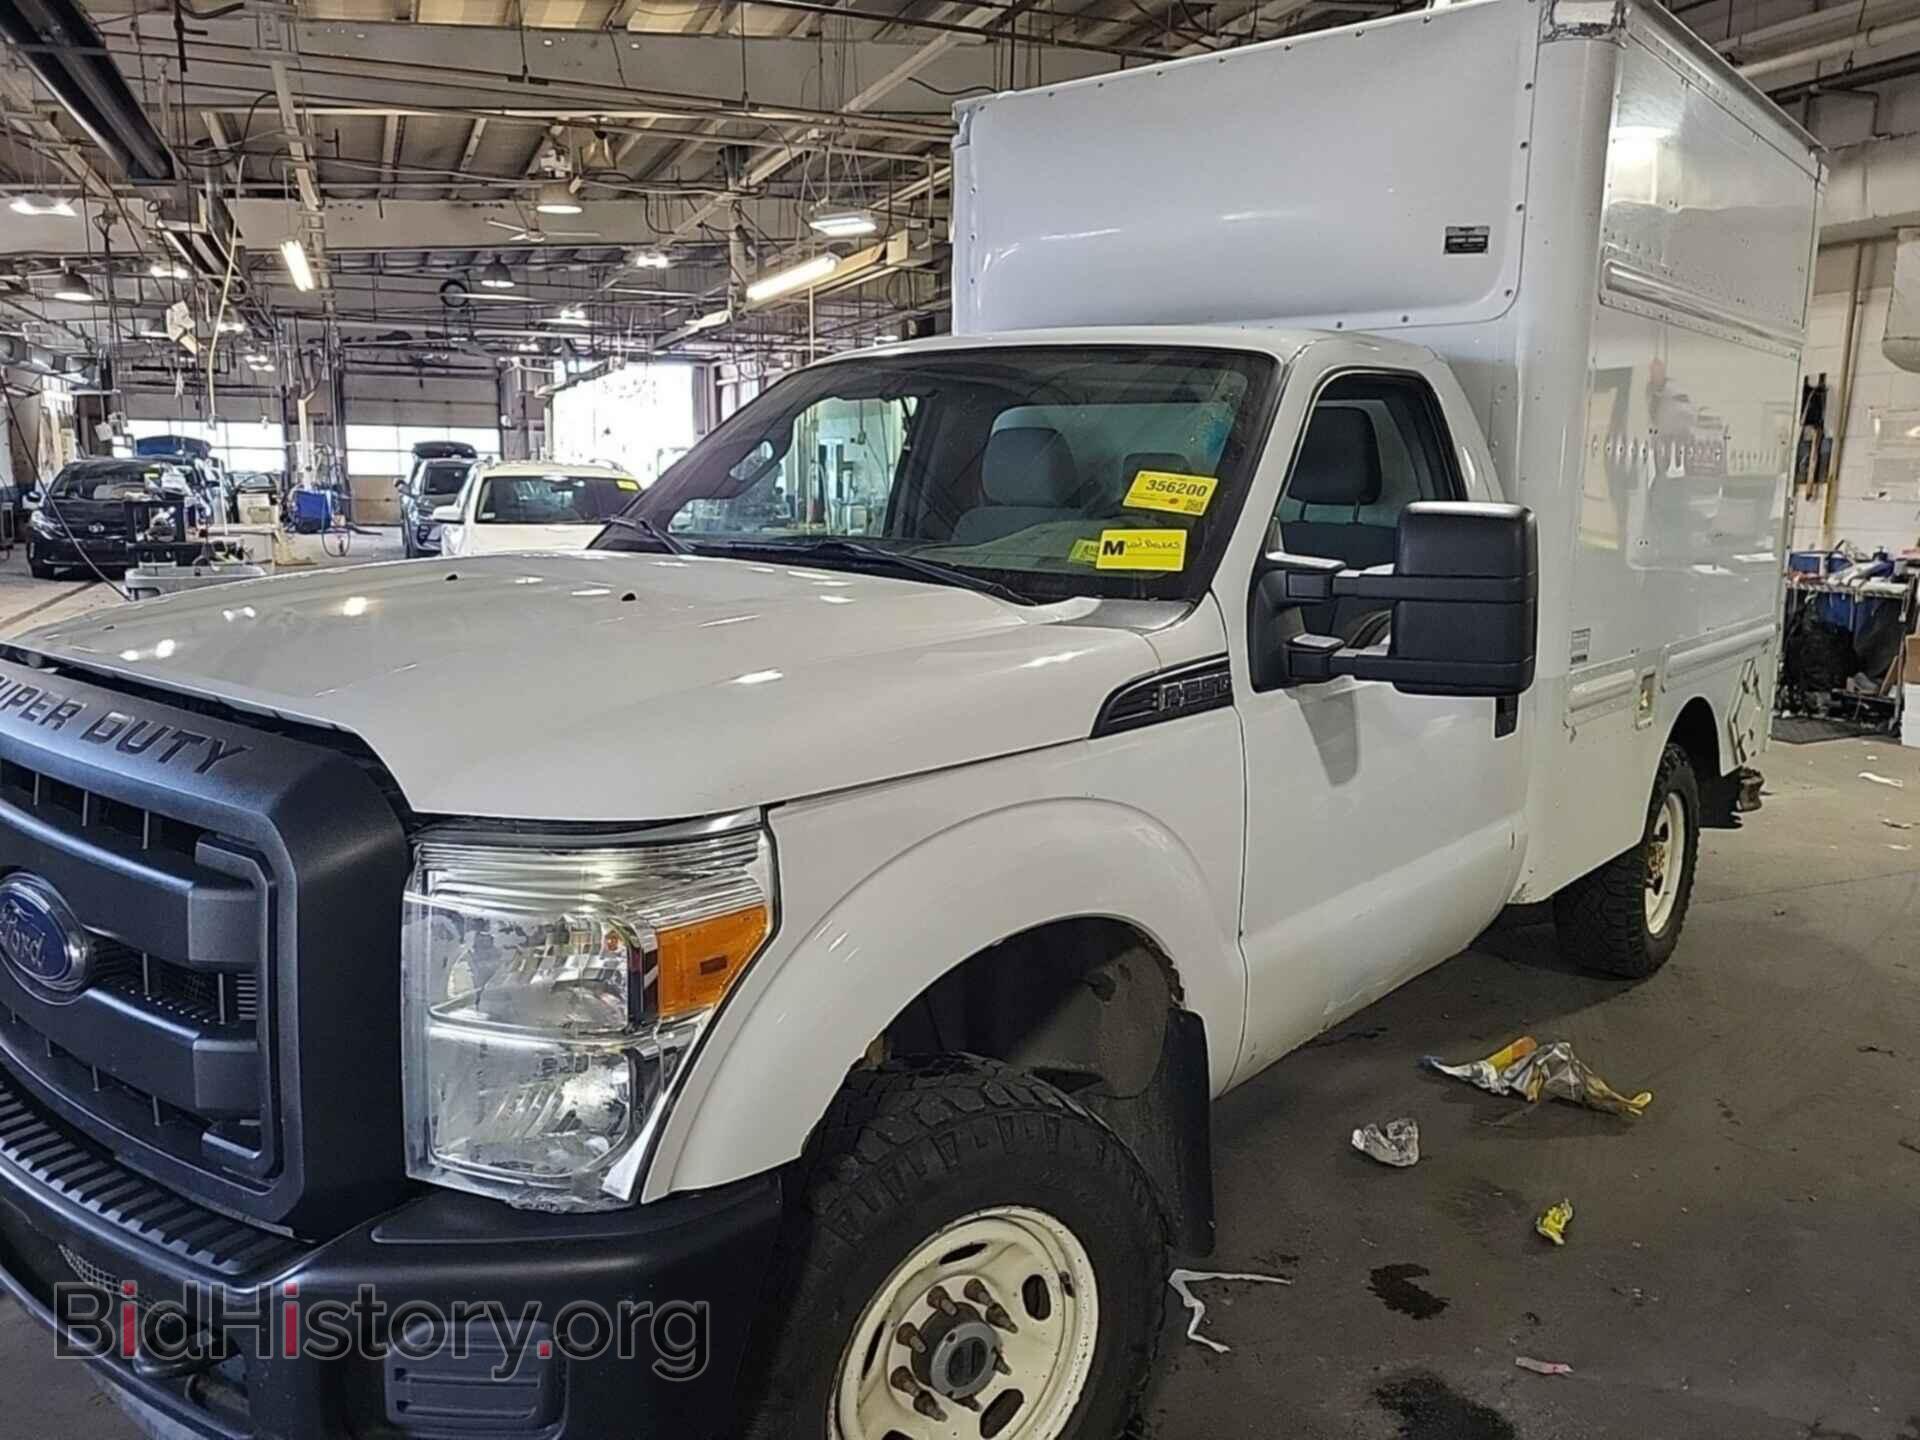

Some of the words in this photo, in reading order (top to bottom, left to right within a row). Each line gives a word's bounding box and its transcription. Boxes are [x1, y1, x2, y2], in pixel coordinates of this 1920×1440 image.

[1146, 479, 1208, 497] 356200
[1103, 540, 1125, 556] M
[0, 673, 87, 731] UPER
[80, 711, 252, 775] DUTY
